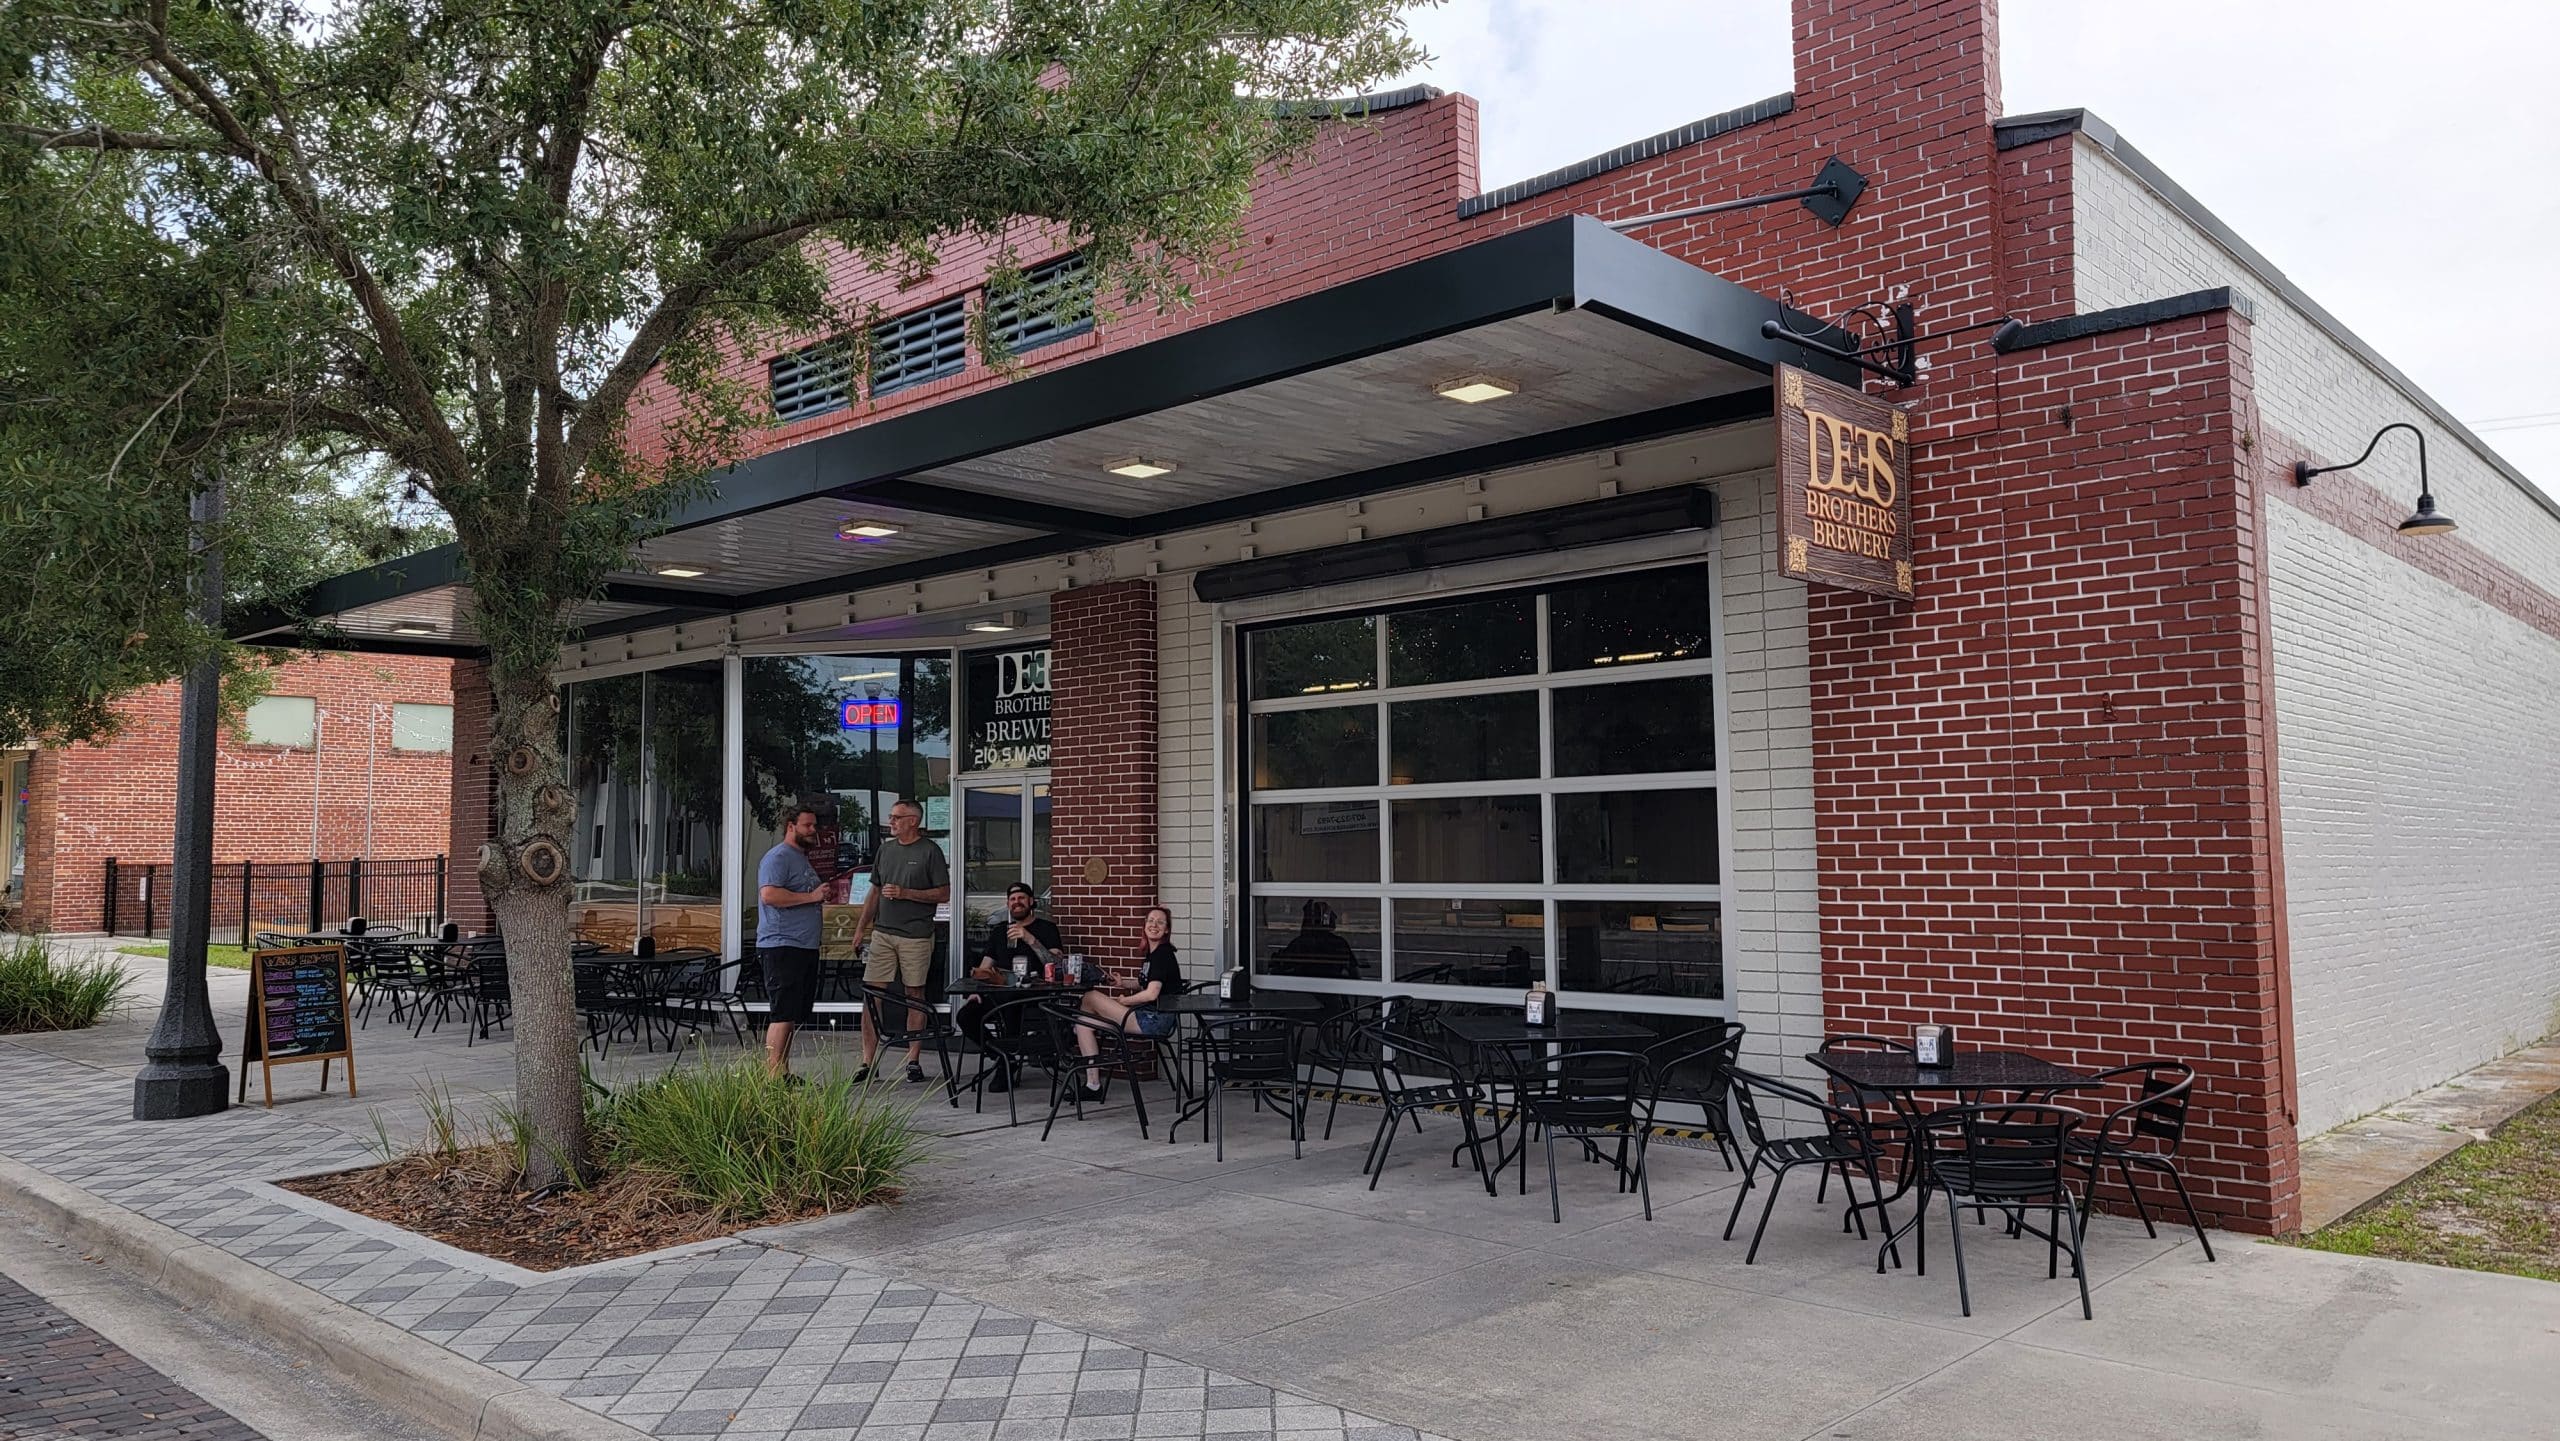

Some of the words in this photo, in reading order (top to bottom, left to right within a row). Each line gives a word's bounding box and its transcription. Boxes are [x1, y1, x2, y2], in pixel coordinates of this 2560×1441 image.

[1804, 409, 1896, 509] DEES
[1806, 490, 1897, 535] BROTHERS
[1813, 520, 1892, 560] BREWERY
[995, 649, 1052, 699] DEE
[845, 703, 897, 725] OPEN
[995, 696, 1051, 715] BROTHE
[985, 717, 1051, 743] BREWE
[974, 746, 998, 764] 210
